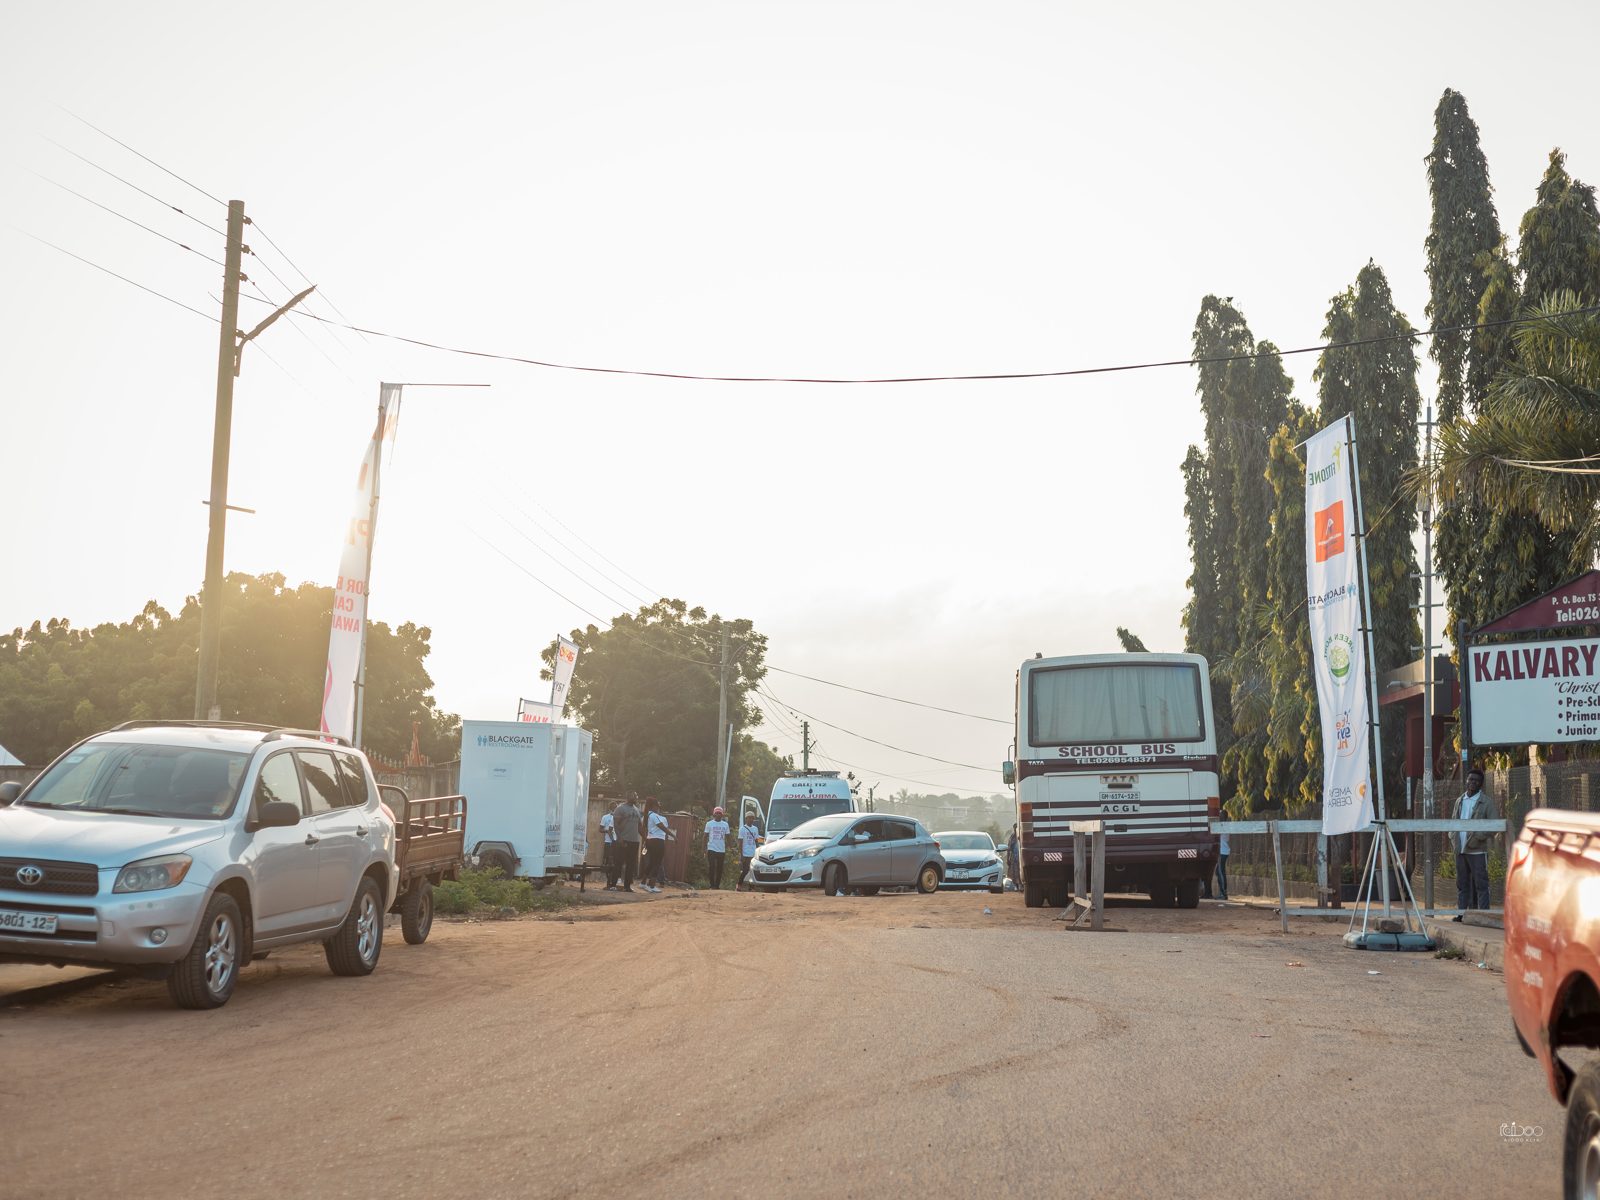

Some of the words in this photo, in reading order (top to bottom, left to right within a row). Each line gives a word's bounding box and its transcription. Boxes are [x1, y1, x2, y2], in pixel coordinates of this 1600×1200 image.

[1572, 595, 1586, 604] Box
[1588, 593, 1597, 602] TS
[1556, 606, 1599, 622] Tel:026
[1474, 644, 1598, 682] KALVARY
[1565, 724, 1598, 736] Junior
[488, 735, 534, 744] BLACKGATE
[1058, 745, 1128, 757] SCHOOL
[1141, 744, 1176, 755] BUS
